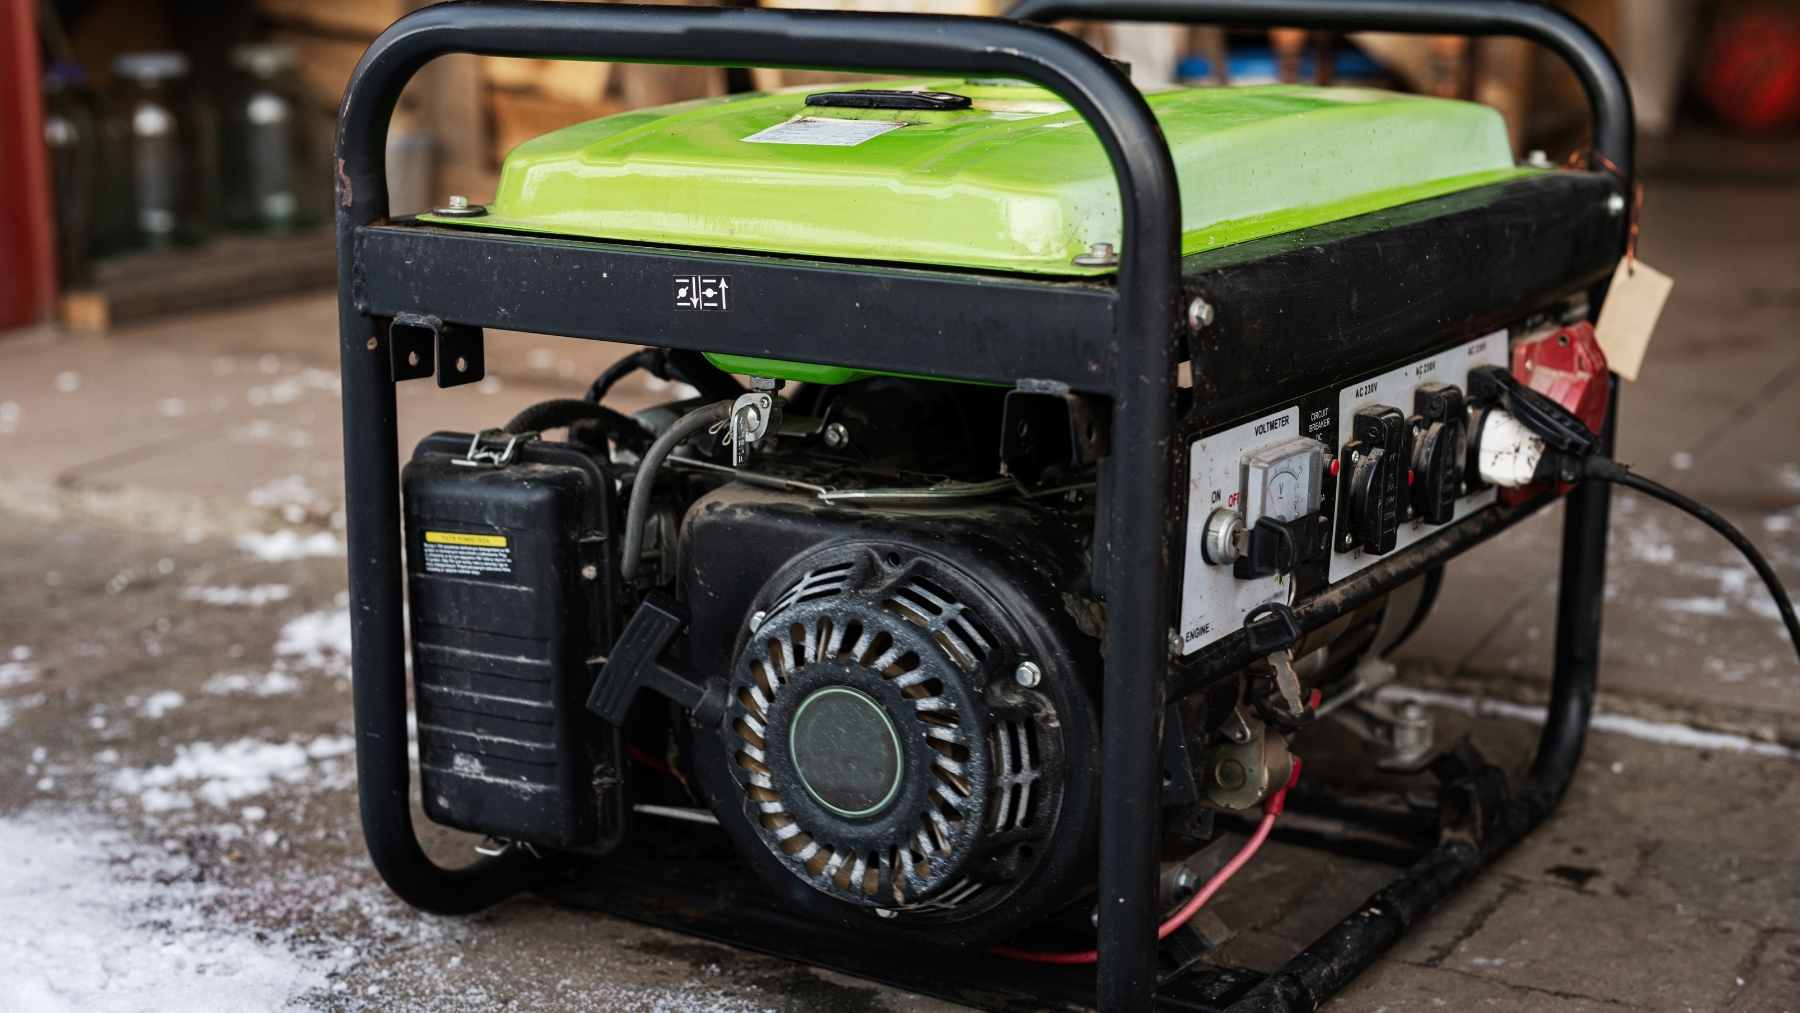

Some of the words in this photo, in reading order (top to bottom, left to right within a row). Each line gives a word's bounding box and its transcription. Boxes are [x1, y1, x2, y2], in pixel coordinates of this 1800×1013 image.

[1355, 384, 1364, 398] AC
[1364, 381, 1378, 396] 230V
[1310, 407, 1329, 422] CIRCUIT
[1254, 415, 1290, 437] VOLTMETER
[1308, 417, 1331, 433] BREAKER
[1211, 488, 1222, 504] ON
[1185, 622, 1210, 643] ENGINE
